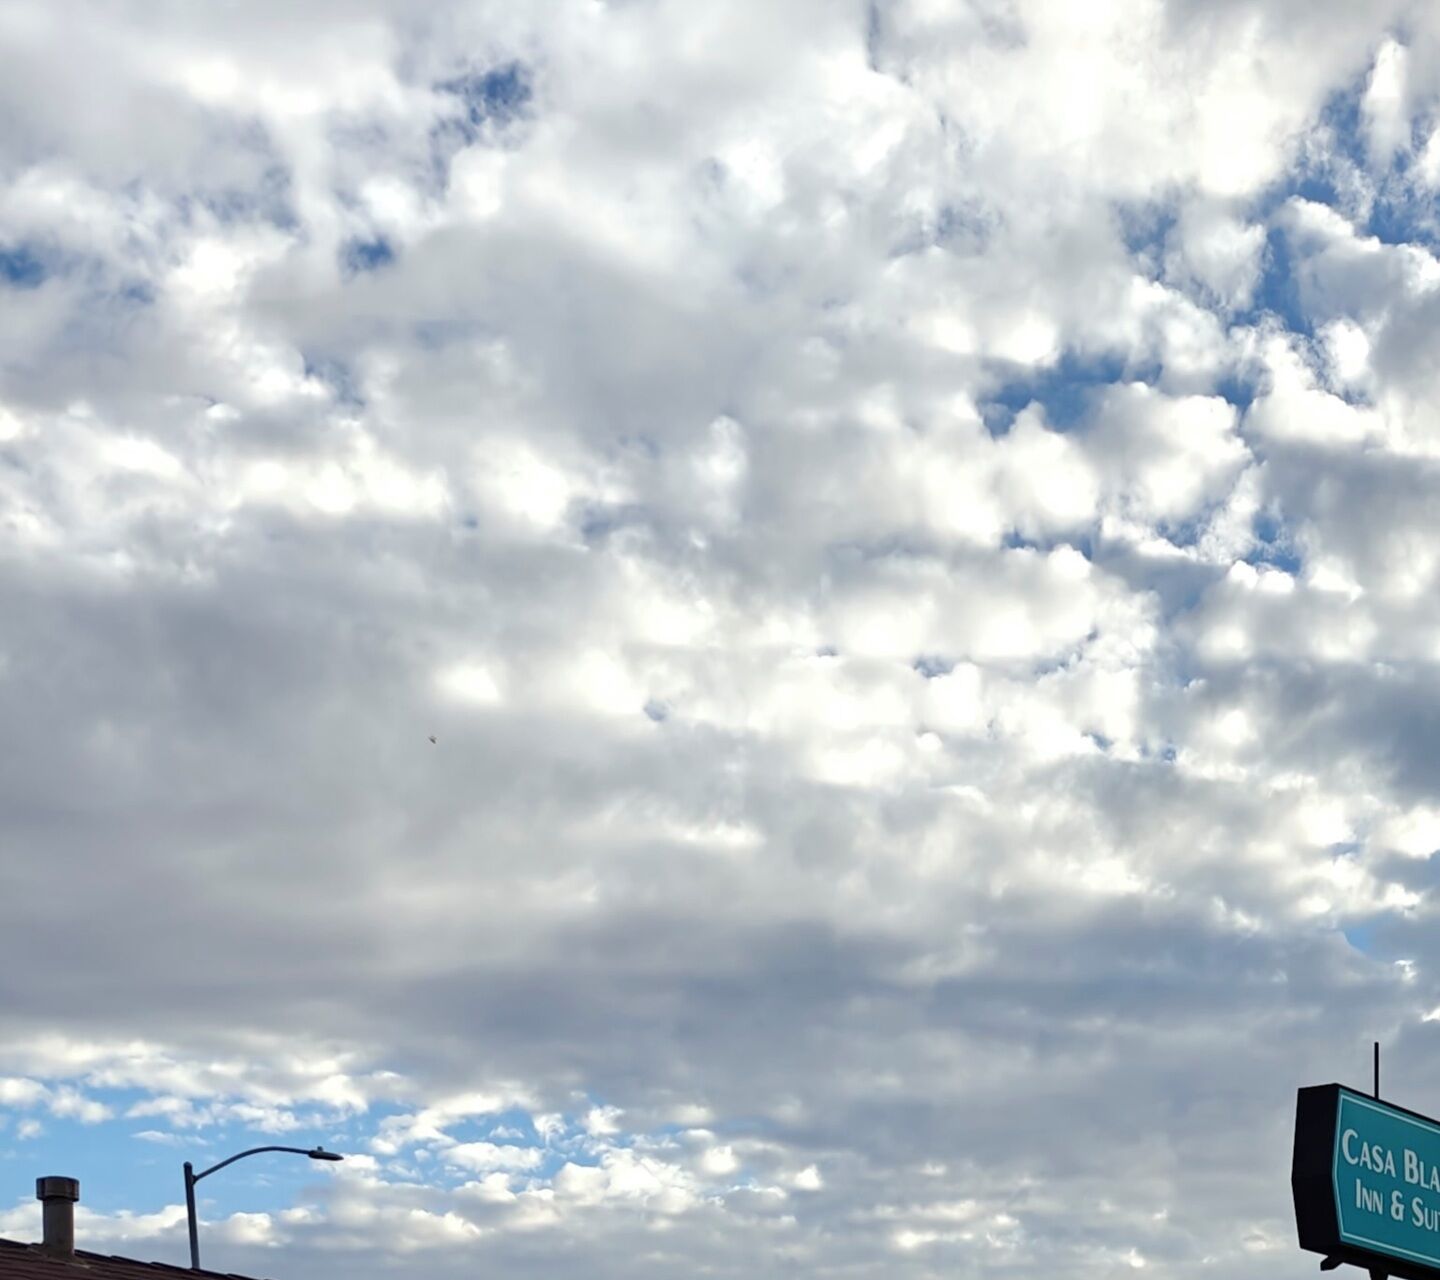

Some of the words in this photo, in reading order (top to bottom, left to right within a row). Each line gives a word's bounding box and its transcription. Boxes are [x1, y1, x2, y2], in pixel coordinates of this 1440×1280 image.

[1341, 1128, 1396, 1178] CASA
[1355, 1178, 1383, 1215] INN
[1390, 1190, 1405, 1221] &
